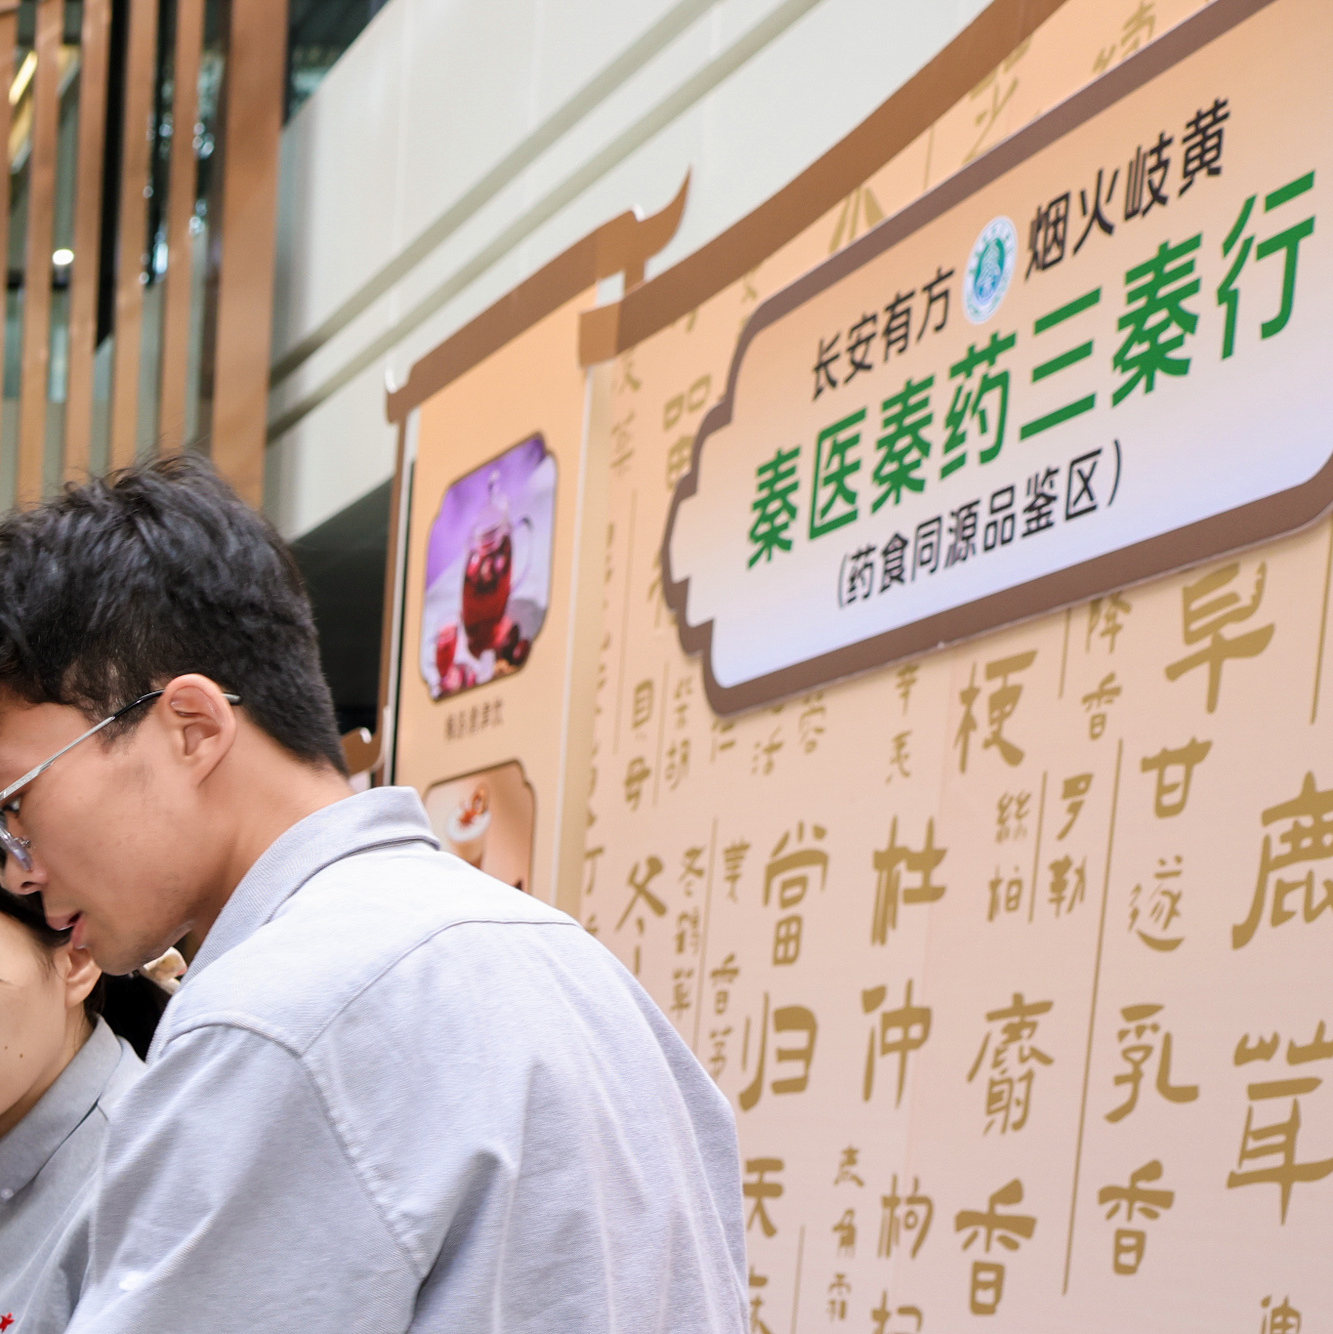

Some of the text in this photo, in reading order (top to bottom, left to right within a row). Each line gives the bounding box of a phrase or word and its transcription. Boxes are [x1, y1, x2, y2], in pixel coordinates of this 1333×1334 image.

[748, 171, 1316, 569] 秦医秦药三秦行
[812, 268, 955, 401] 长安有方
[1025, 97, 1229, 280] 烟火岐黄
[836, 439, 1123, 609] (药食同源品鉴区)
